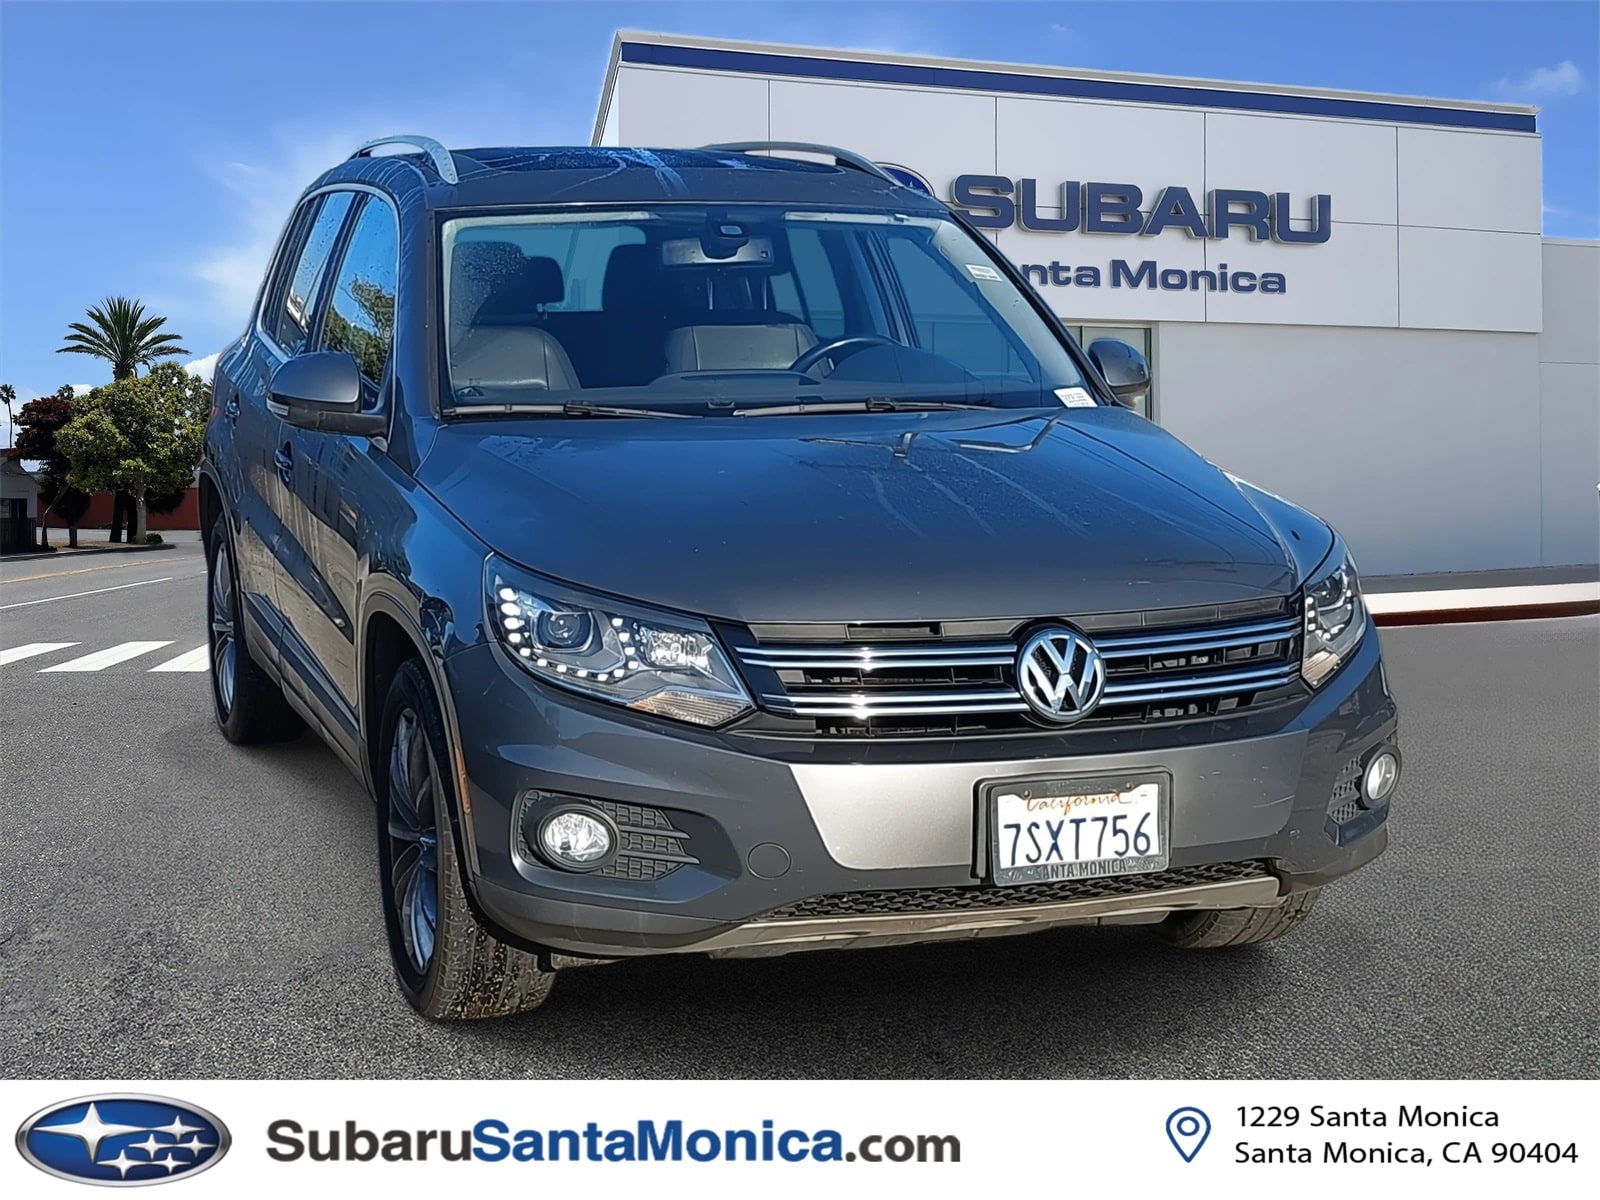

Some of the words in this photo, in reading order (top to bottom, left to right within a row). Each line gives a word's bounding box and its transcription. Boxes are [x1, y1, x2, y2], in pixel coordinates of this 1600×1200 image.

[951, 174, 1332, 245] SUBARU
[1020, 260, 1101, 288] nta
[1110, 259, 1288, 294] Monica
[1003, 812, 1151, 866] 7SXT756
